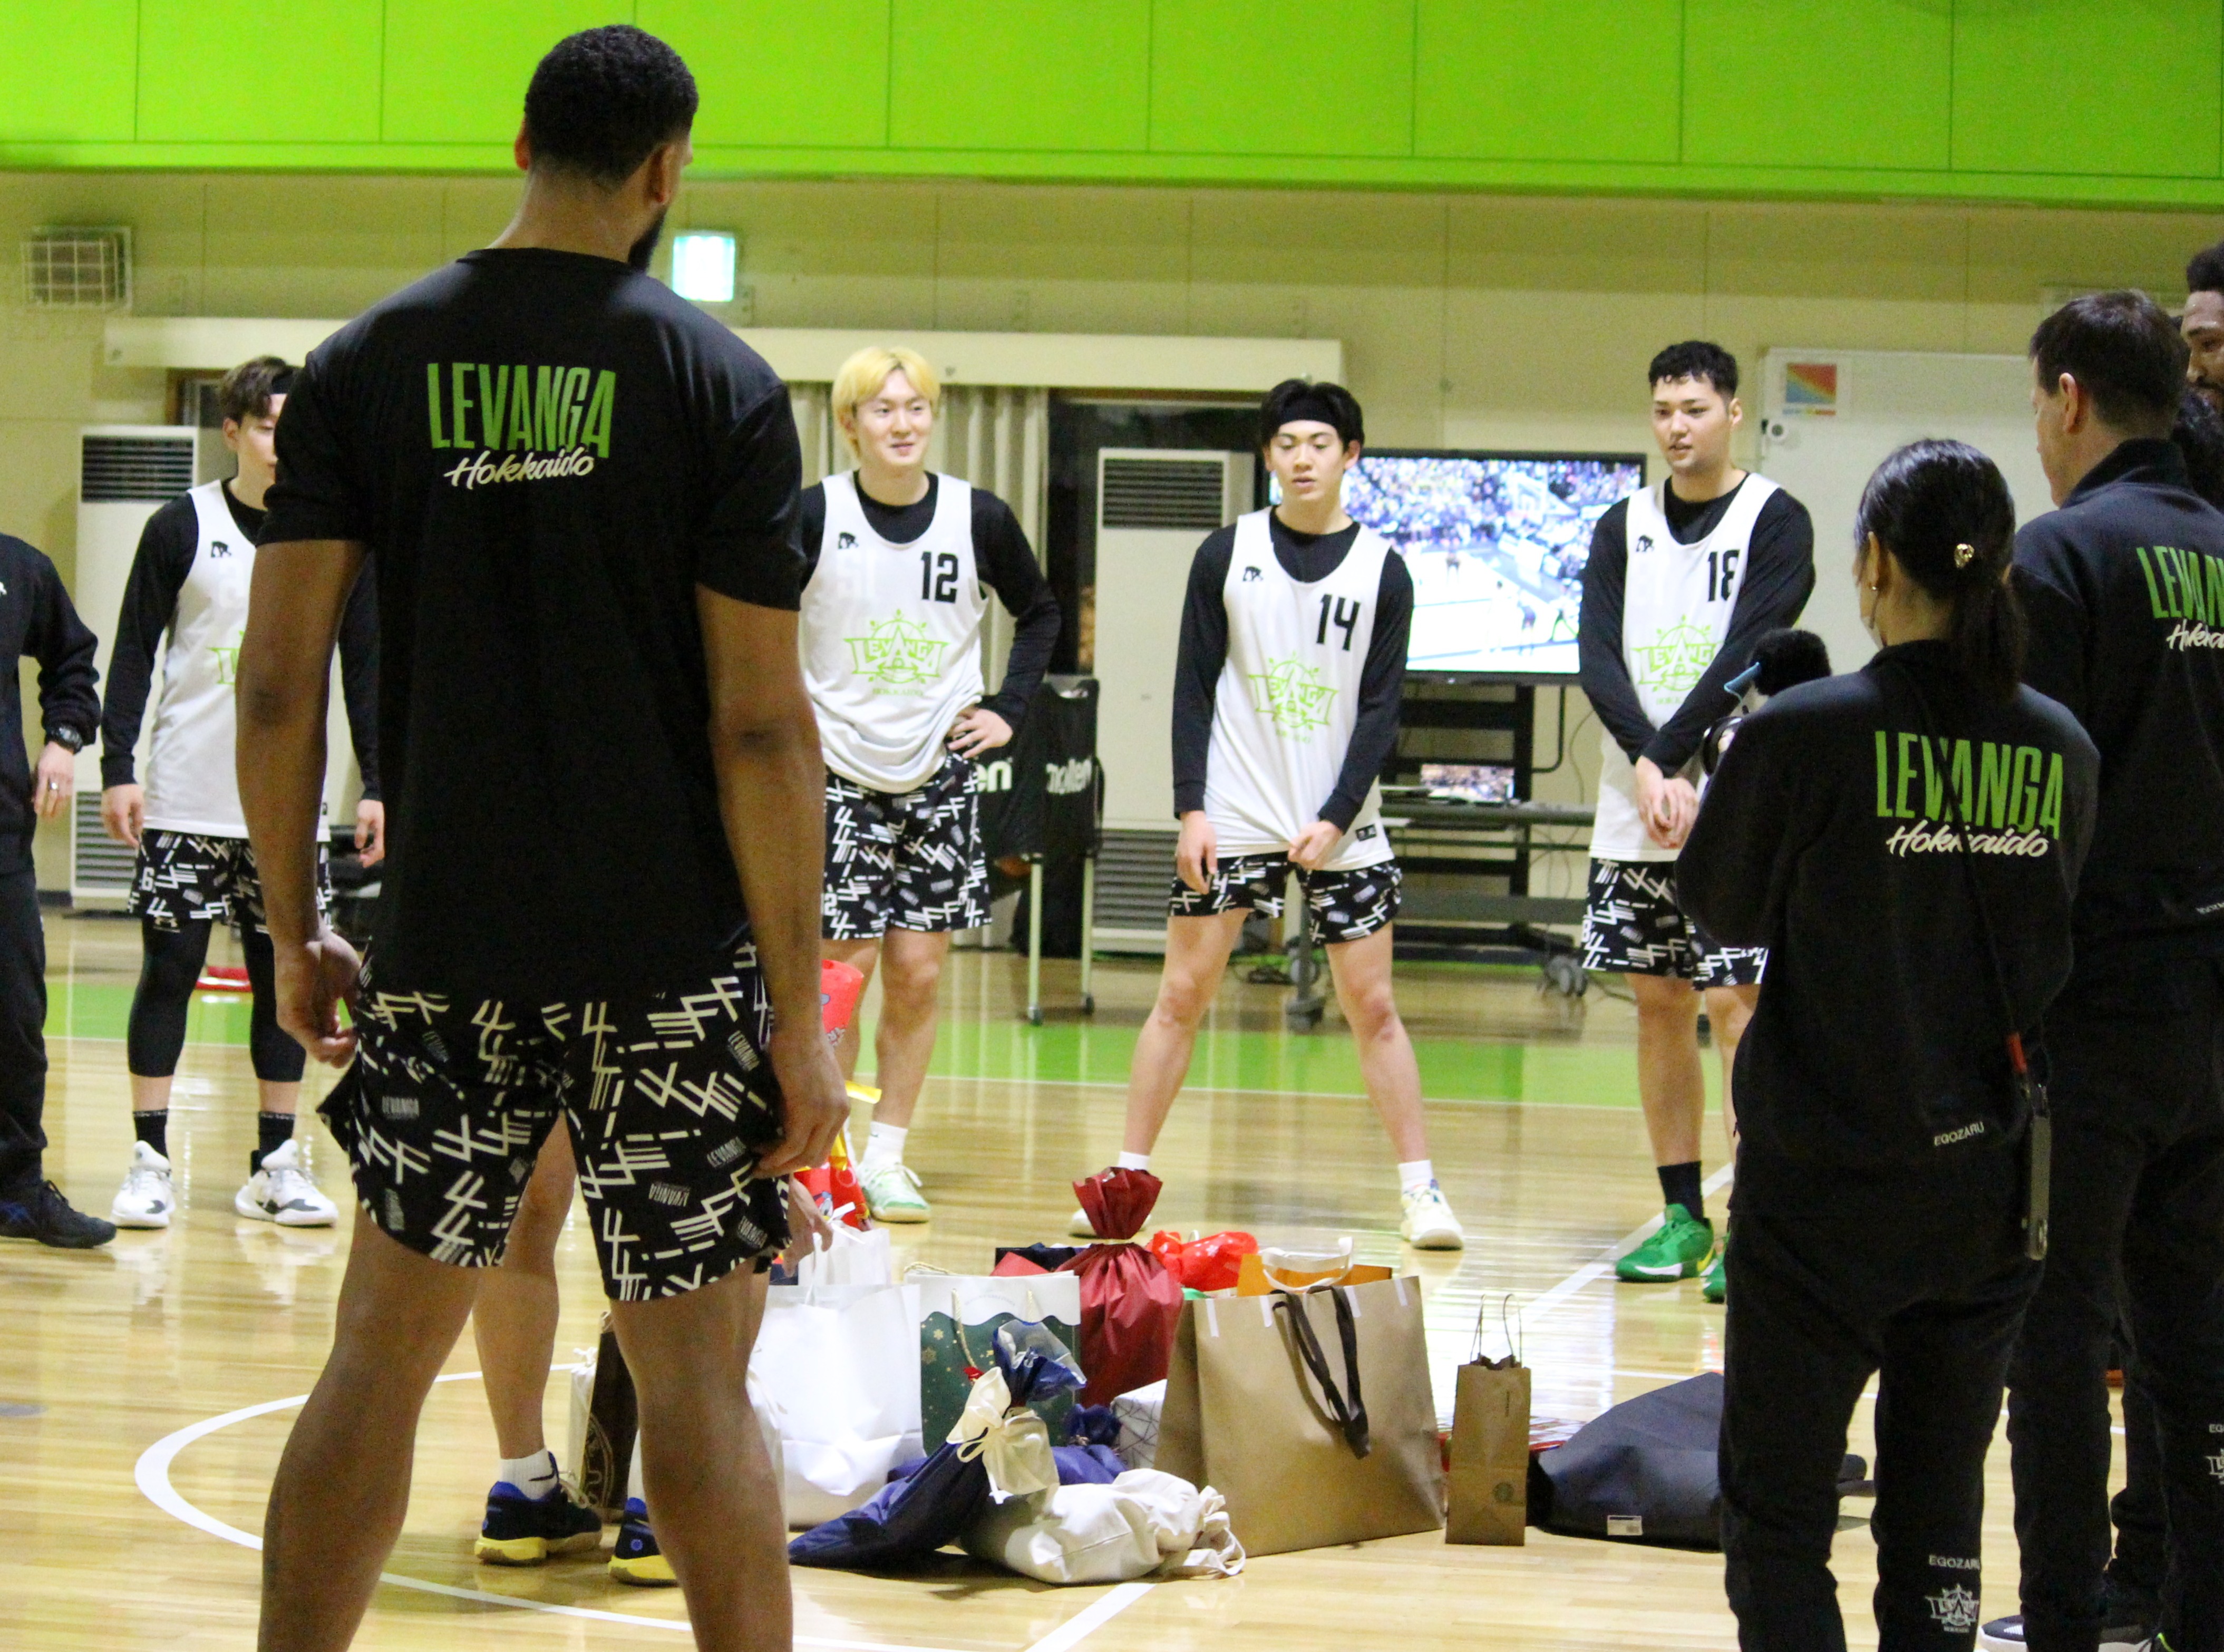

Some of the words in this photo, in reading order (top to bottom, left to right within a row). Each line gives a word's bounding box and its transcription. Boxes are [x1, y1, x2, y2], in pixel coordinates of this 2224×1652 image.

[427, 362, 616, 458] LEVANGA
[443, 446, 595, 490] Hokkaido
[920, 551, 958, 604] 12
[1316, 594, 1361, 651] 14
[1630, 633, 1723, 684] LEVANG
[1875, 731, 2063, 840] LEVANGA
[1934, 1121, 1985, 1146] EGOZARU
